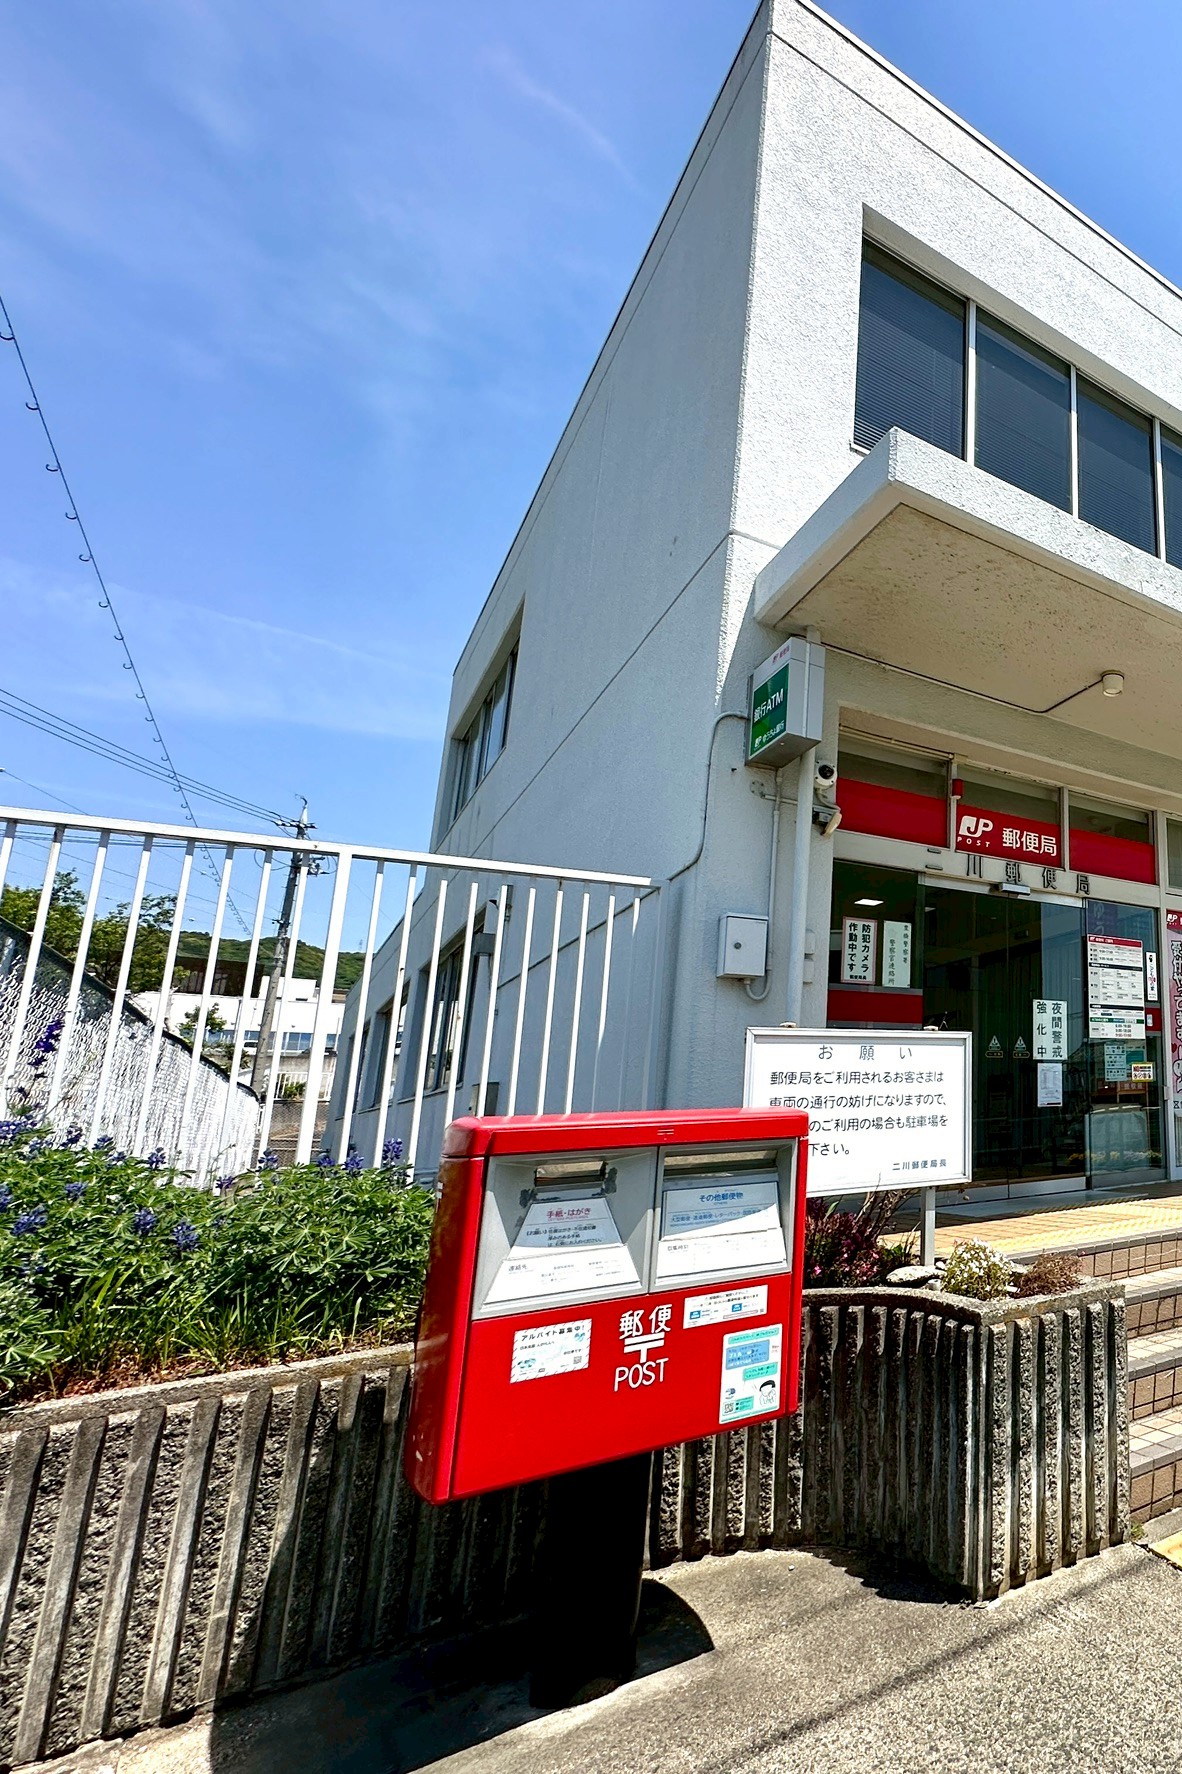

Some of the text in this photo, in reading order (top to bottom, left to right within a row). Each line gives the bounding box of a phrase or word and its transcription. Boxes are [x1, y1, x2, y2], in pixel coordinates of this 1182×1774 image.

[754, 688, 784, 723] 銀行ATM
[957, 836, 991, 848] POST
[1002, 827, 1057, 857] 郵便局
[925, 848, 1091, 896] 二川郵便局
[847, 922, 858, 972] 作動中です
[861, 923, 871, 973] 防犯カメラ
[1036, 1001, 1048, 1058] 強化中
[1051, 1002, 1063, 1058] 夜間警戒
[818, 1044, 913, 1061] お願い
[770, 1071, 944, 1086] 郵便局をご利用されるお客さまは
[769, 1093, 947, 1110] 車両の通行の妨げになりますので、
[808, 1142, 851, 1157] 下さい。
[892, 1158, 948, 1171] 二川郵便局長
[699, 1191, 744, 1202] その他郵便物
[546, 1207, 591, 1219] 手紙・はがき
[619, 1304, 673, 1339] 郵便
[614, 1357, 669, 1392] POST
